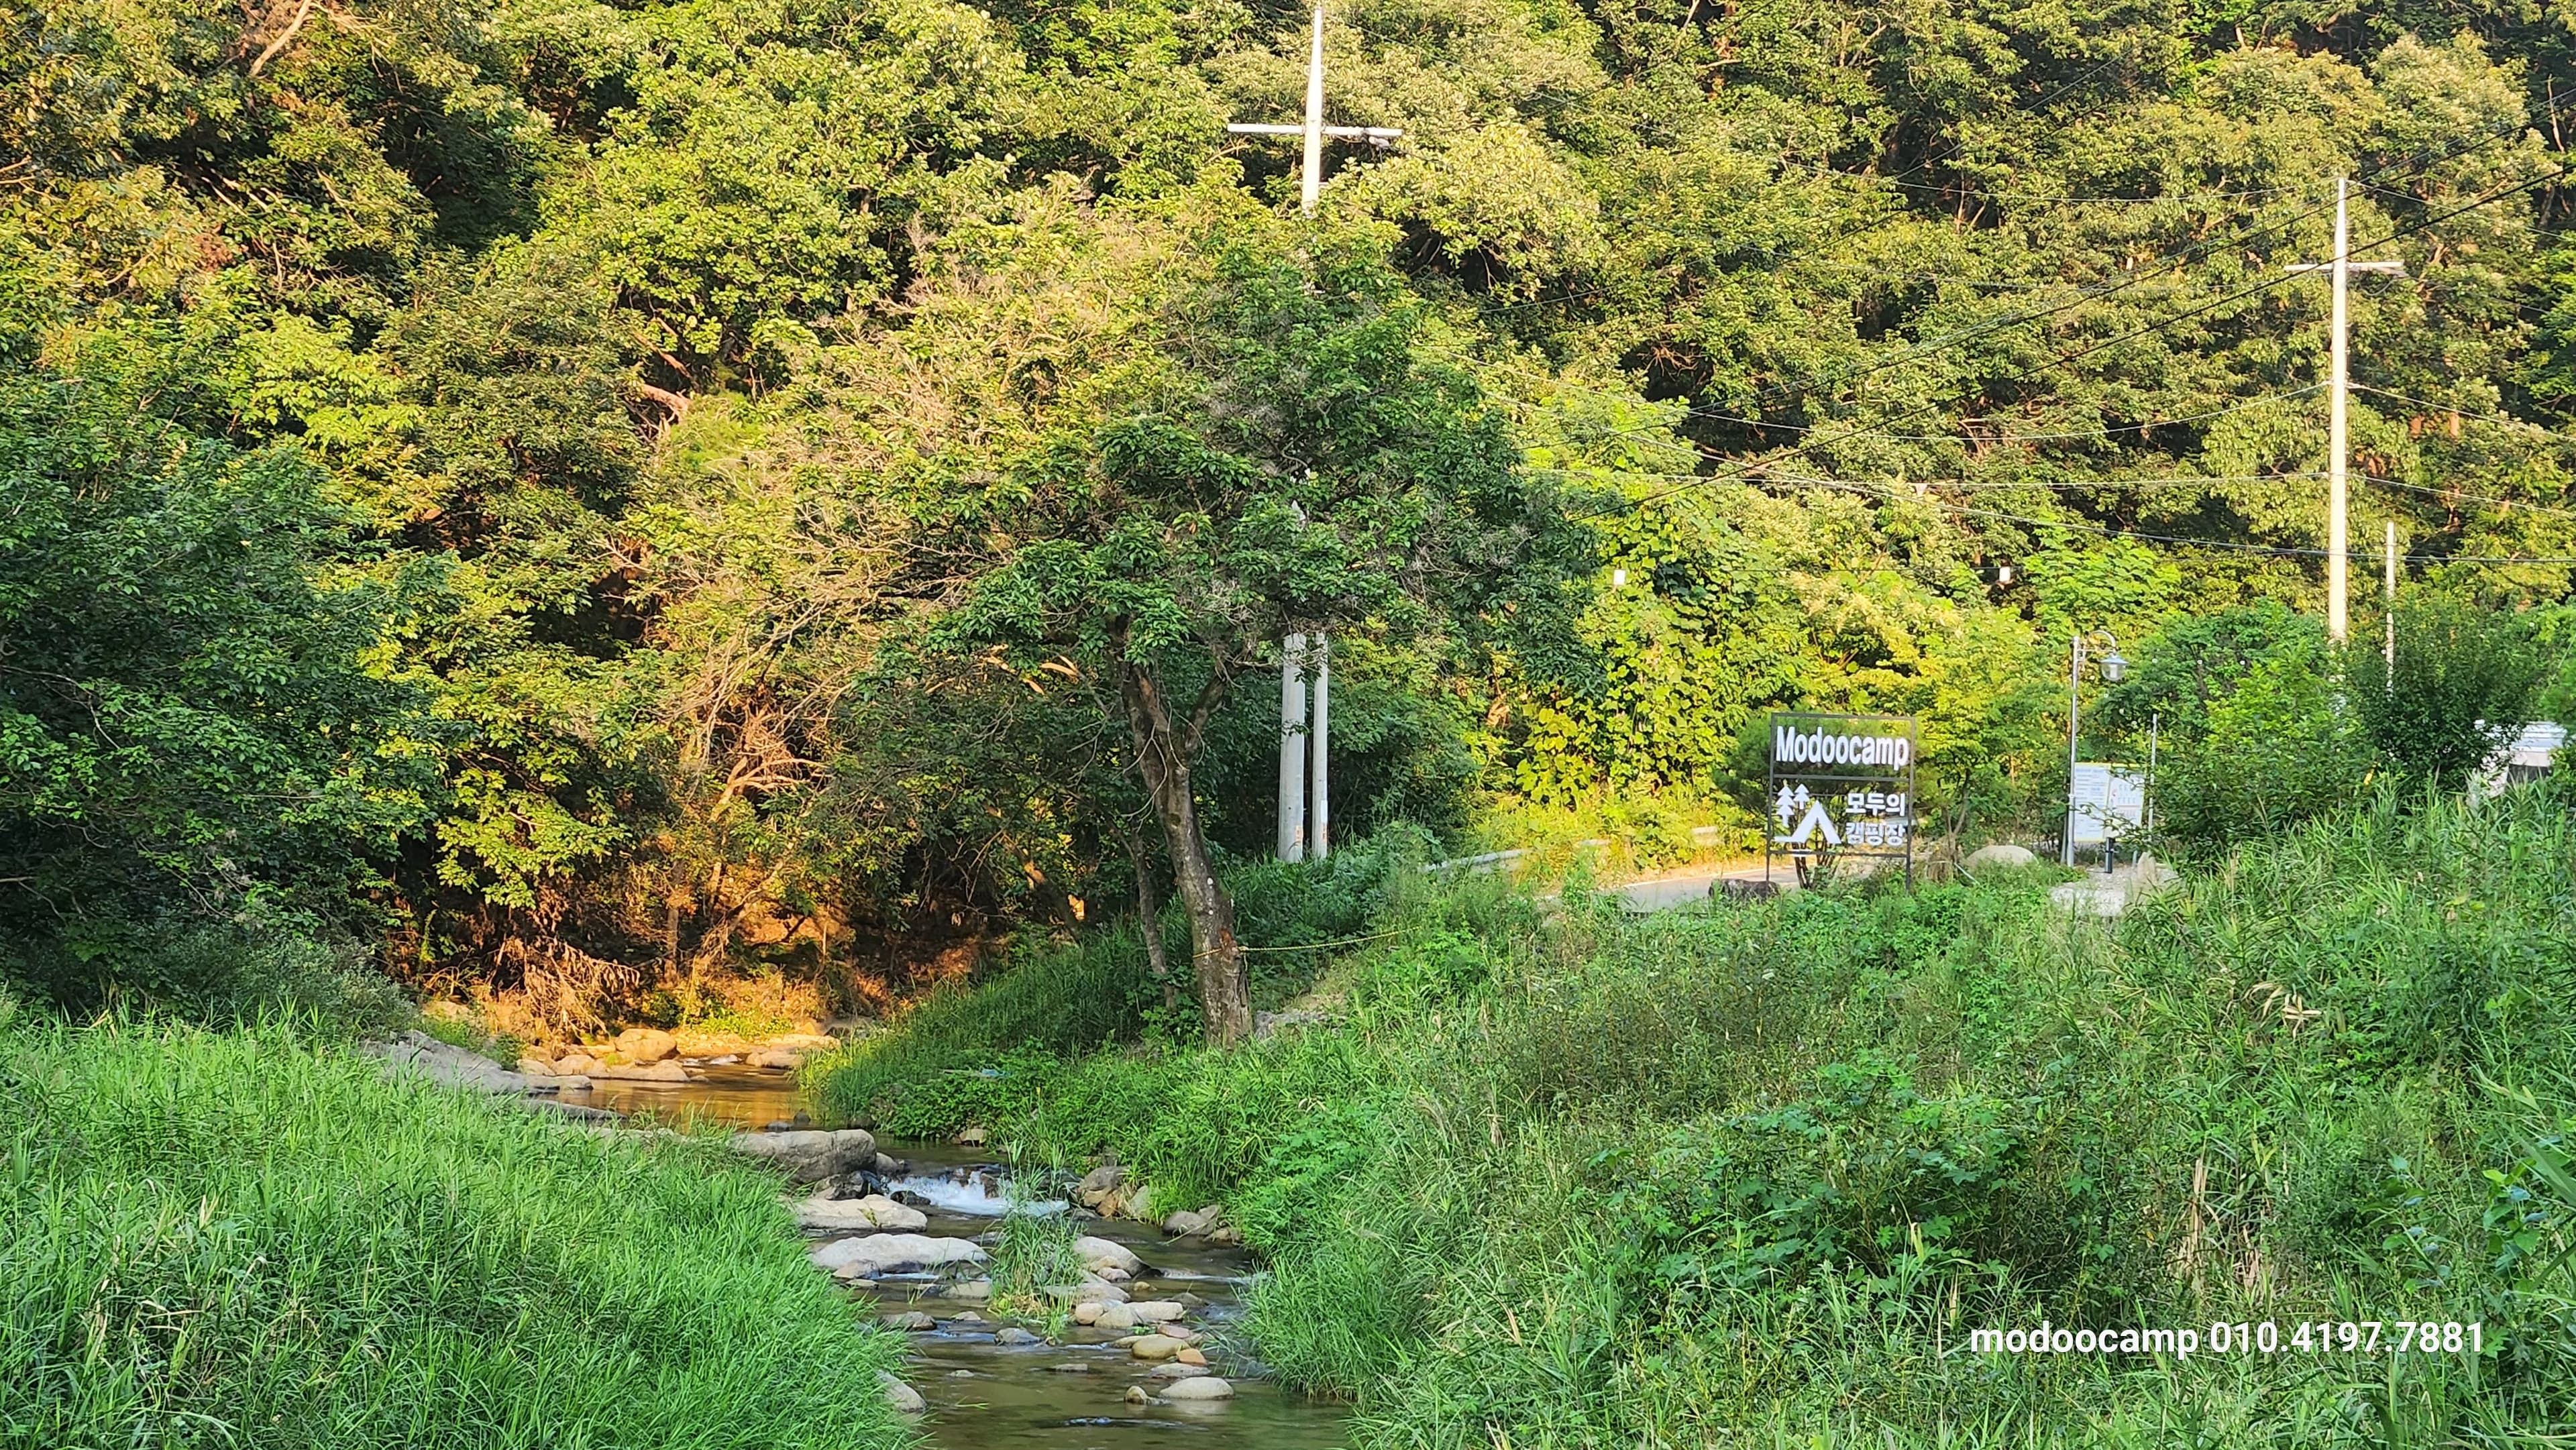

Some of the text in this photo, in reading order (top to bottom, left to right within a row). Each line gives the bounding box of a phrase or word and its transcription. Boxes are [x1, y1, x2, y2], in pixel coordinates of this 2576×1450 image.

[1775, 725, 1910, 771] Modoocamp
[1845, 792, 1906, 817] 모두의
[1845, 822, 1907, 846] 캠핑장
